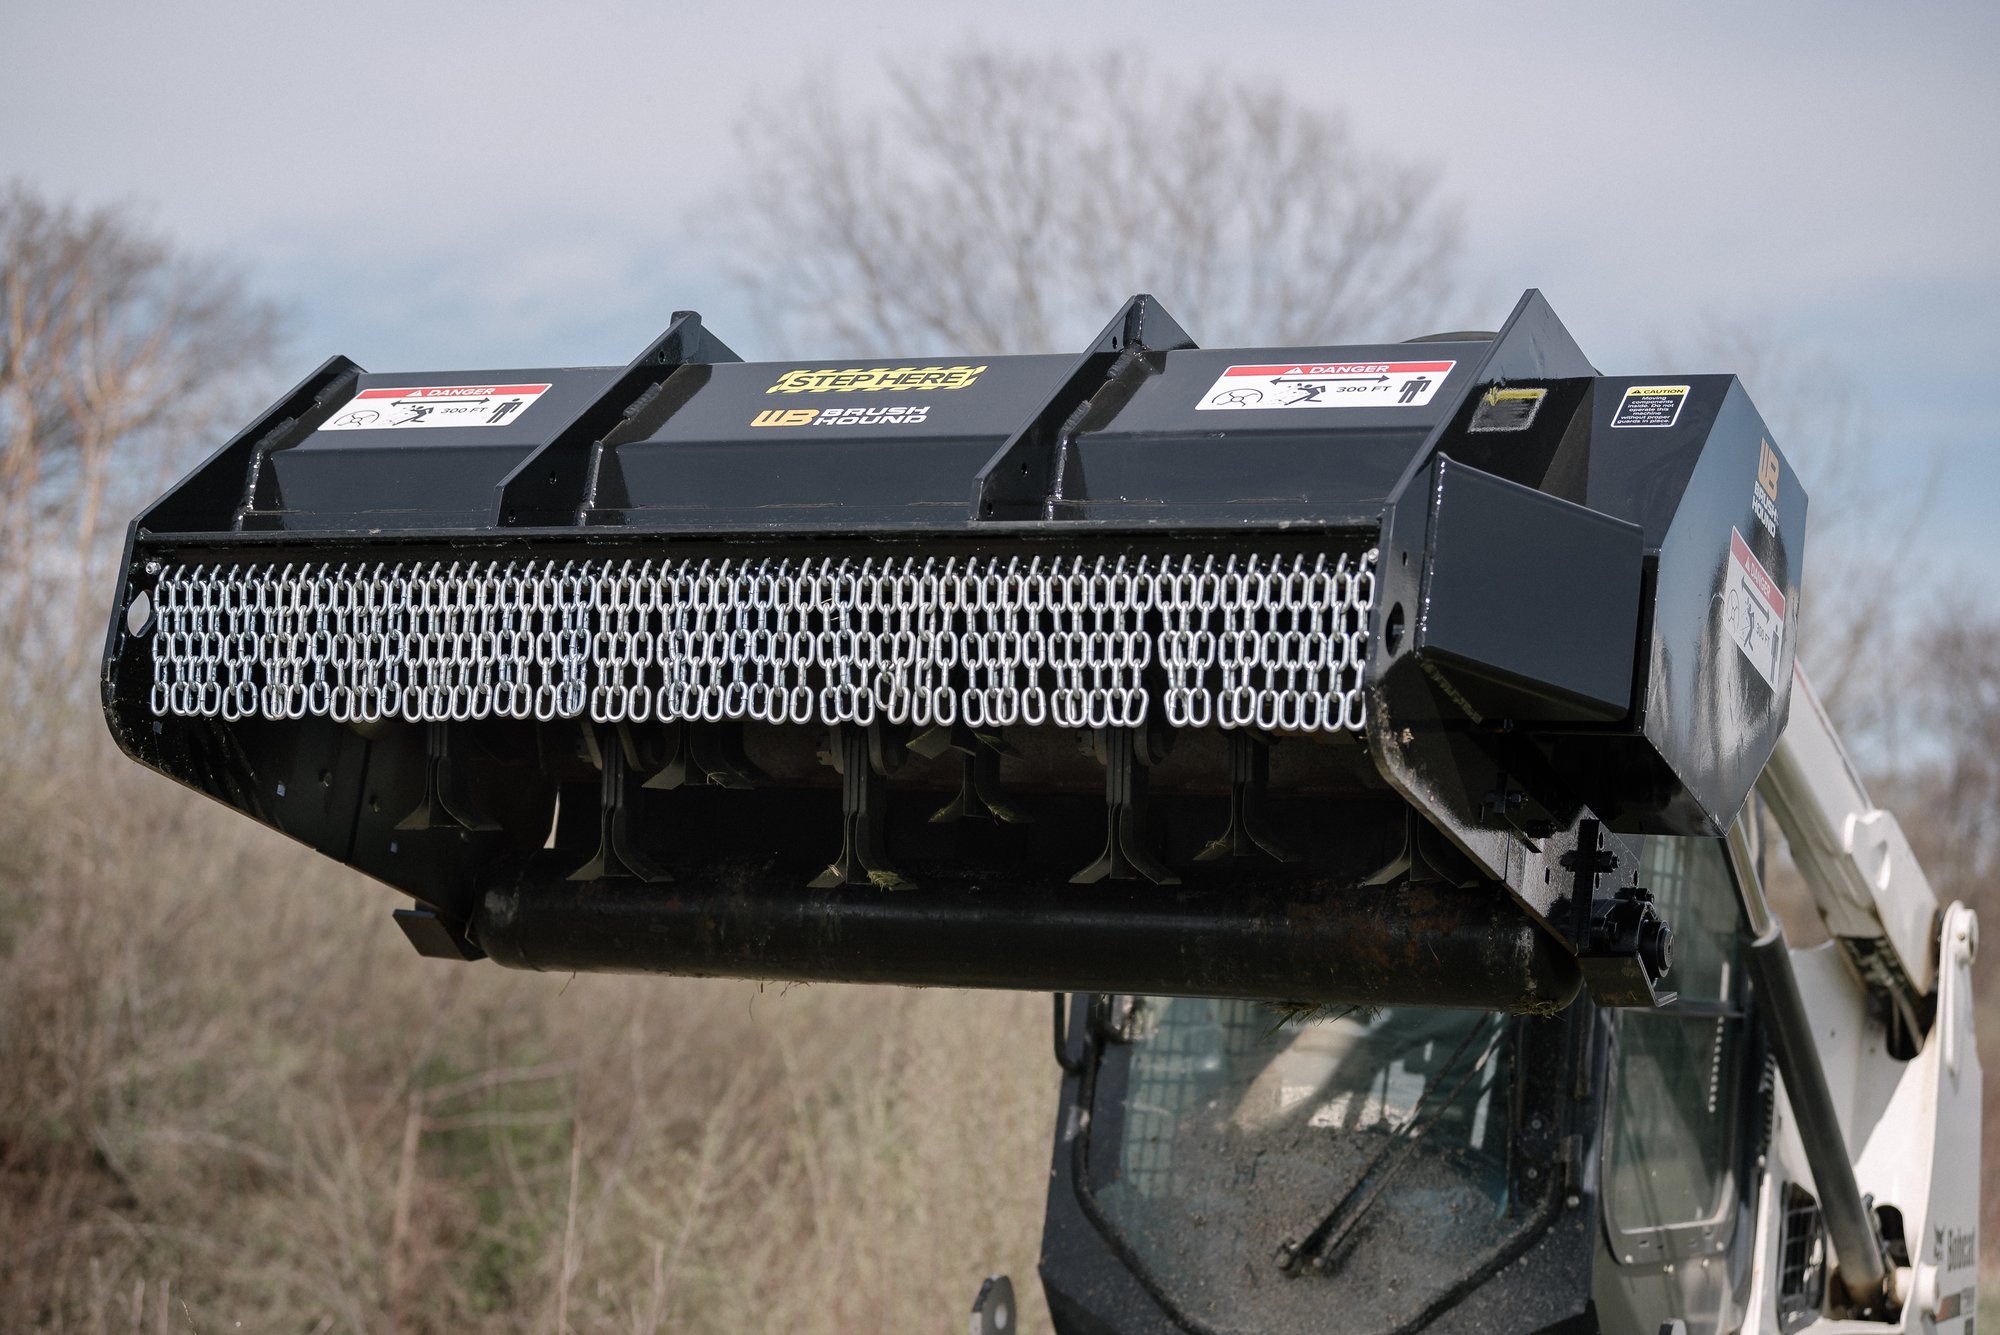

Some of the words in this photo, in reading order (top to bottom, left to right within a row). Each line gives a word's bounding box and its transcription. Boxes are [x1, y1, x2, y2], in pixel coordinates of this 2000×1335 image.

[1309, 365, 1390, 374] DANGER
[788, 373, 875, 387] STEP
[876, 371, 967, 386] HERE
[426, 387, 496, 397] DANGER
[820, 406, 931, 417] BRUSH
[812, 414, 928, 426] HOUND
[1753, 480, 1777, 520] BRUSH
[1751, 498, 1776, 538] HOUND
[1750, 562, 1771, 599] DANGER
[1755, 622, 1764, 642] 300
